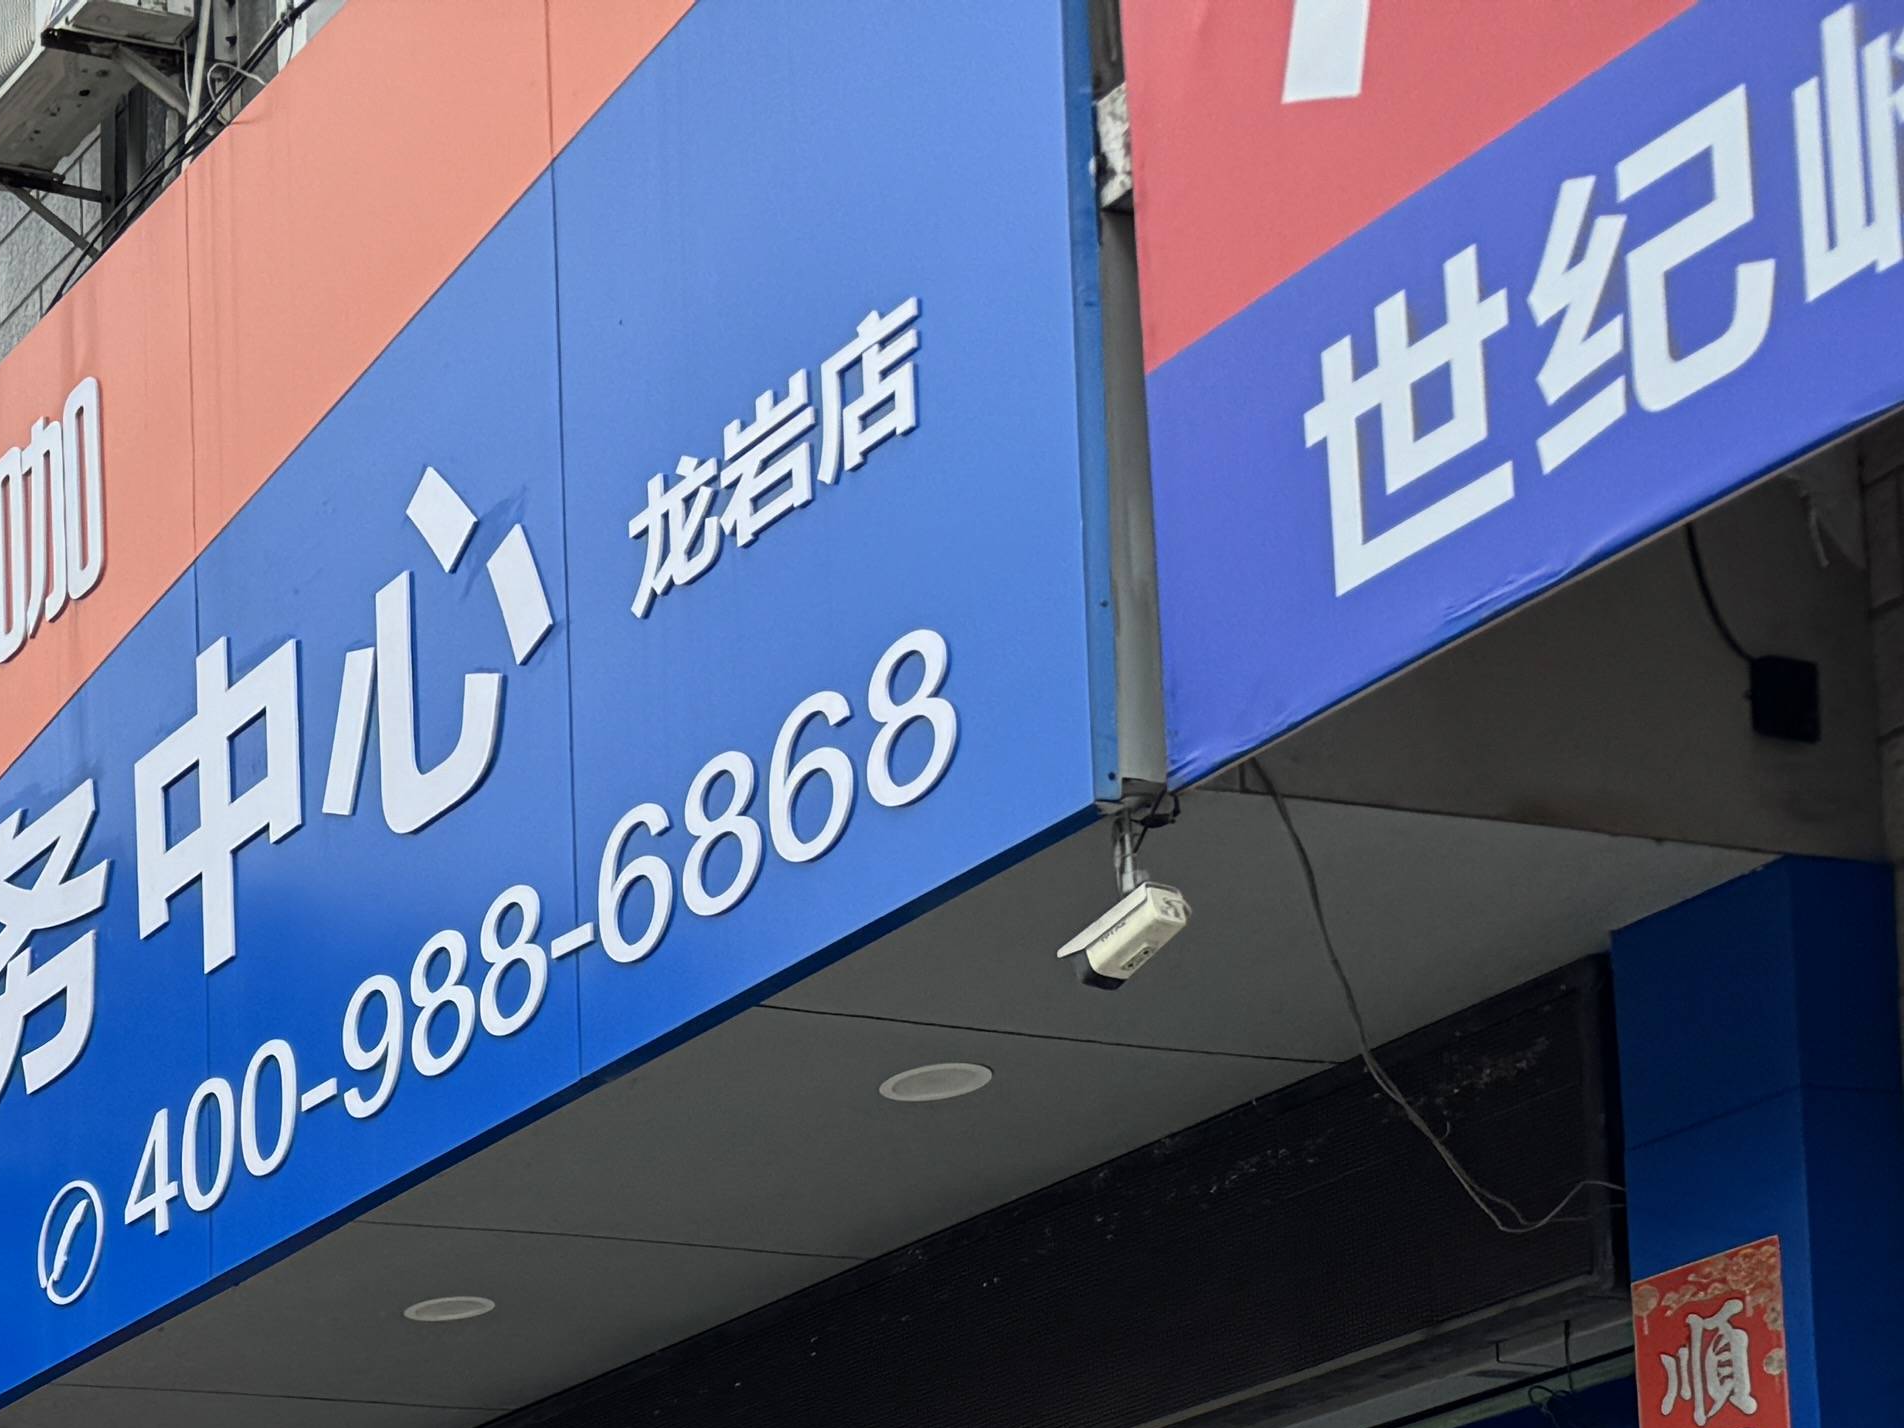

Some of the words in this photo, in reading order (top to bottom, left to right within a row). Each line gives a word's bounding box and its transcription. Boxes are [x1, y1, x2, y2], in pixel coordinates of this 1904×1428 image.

[628, 296, 923, 618] 龙岩店
[125, 630, 959, 1236] 400-988-6868
